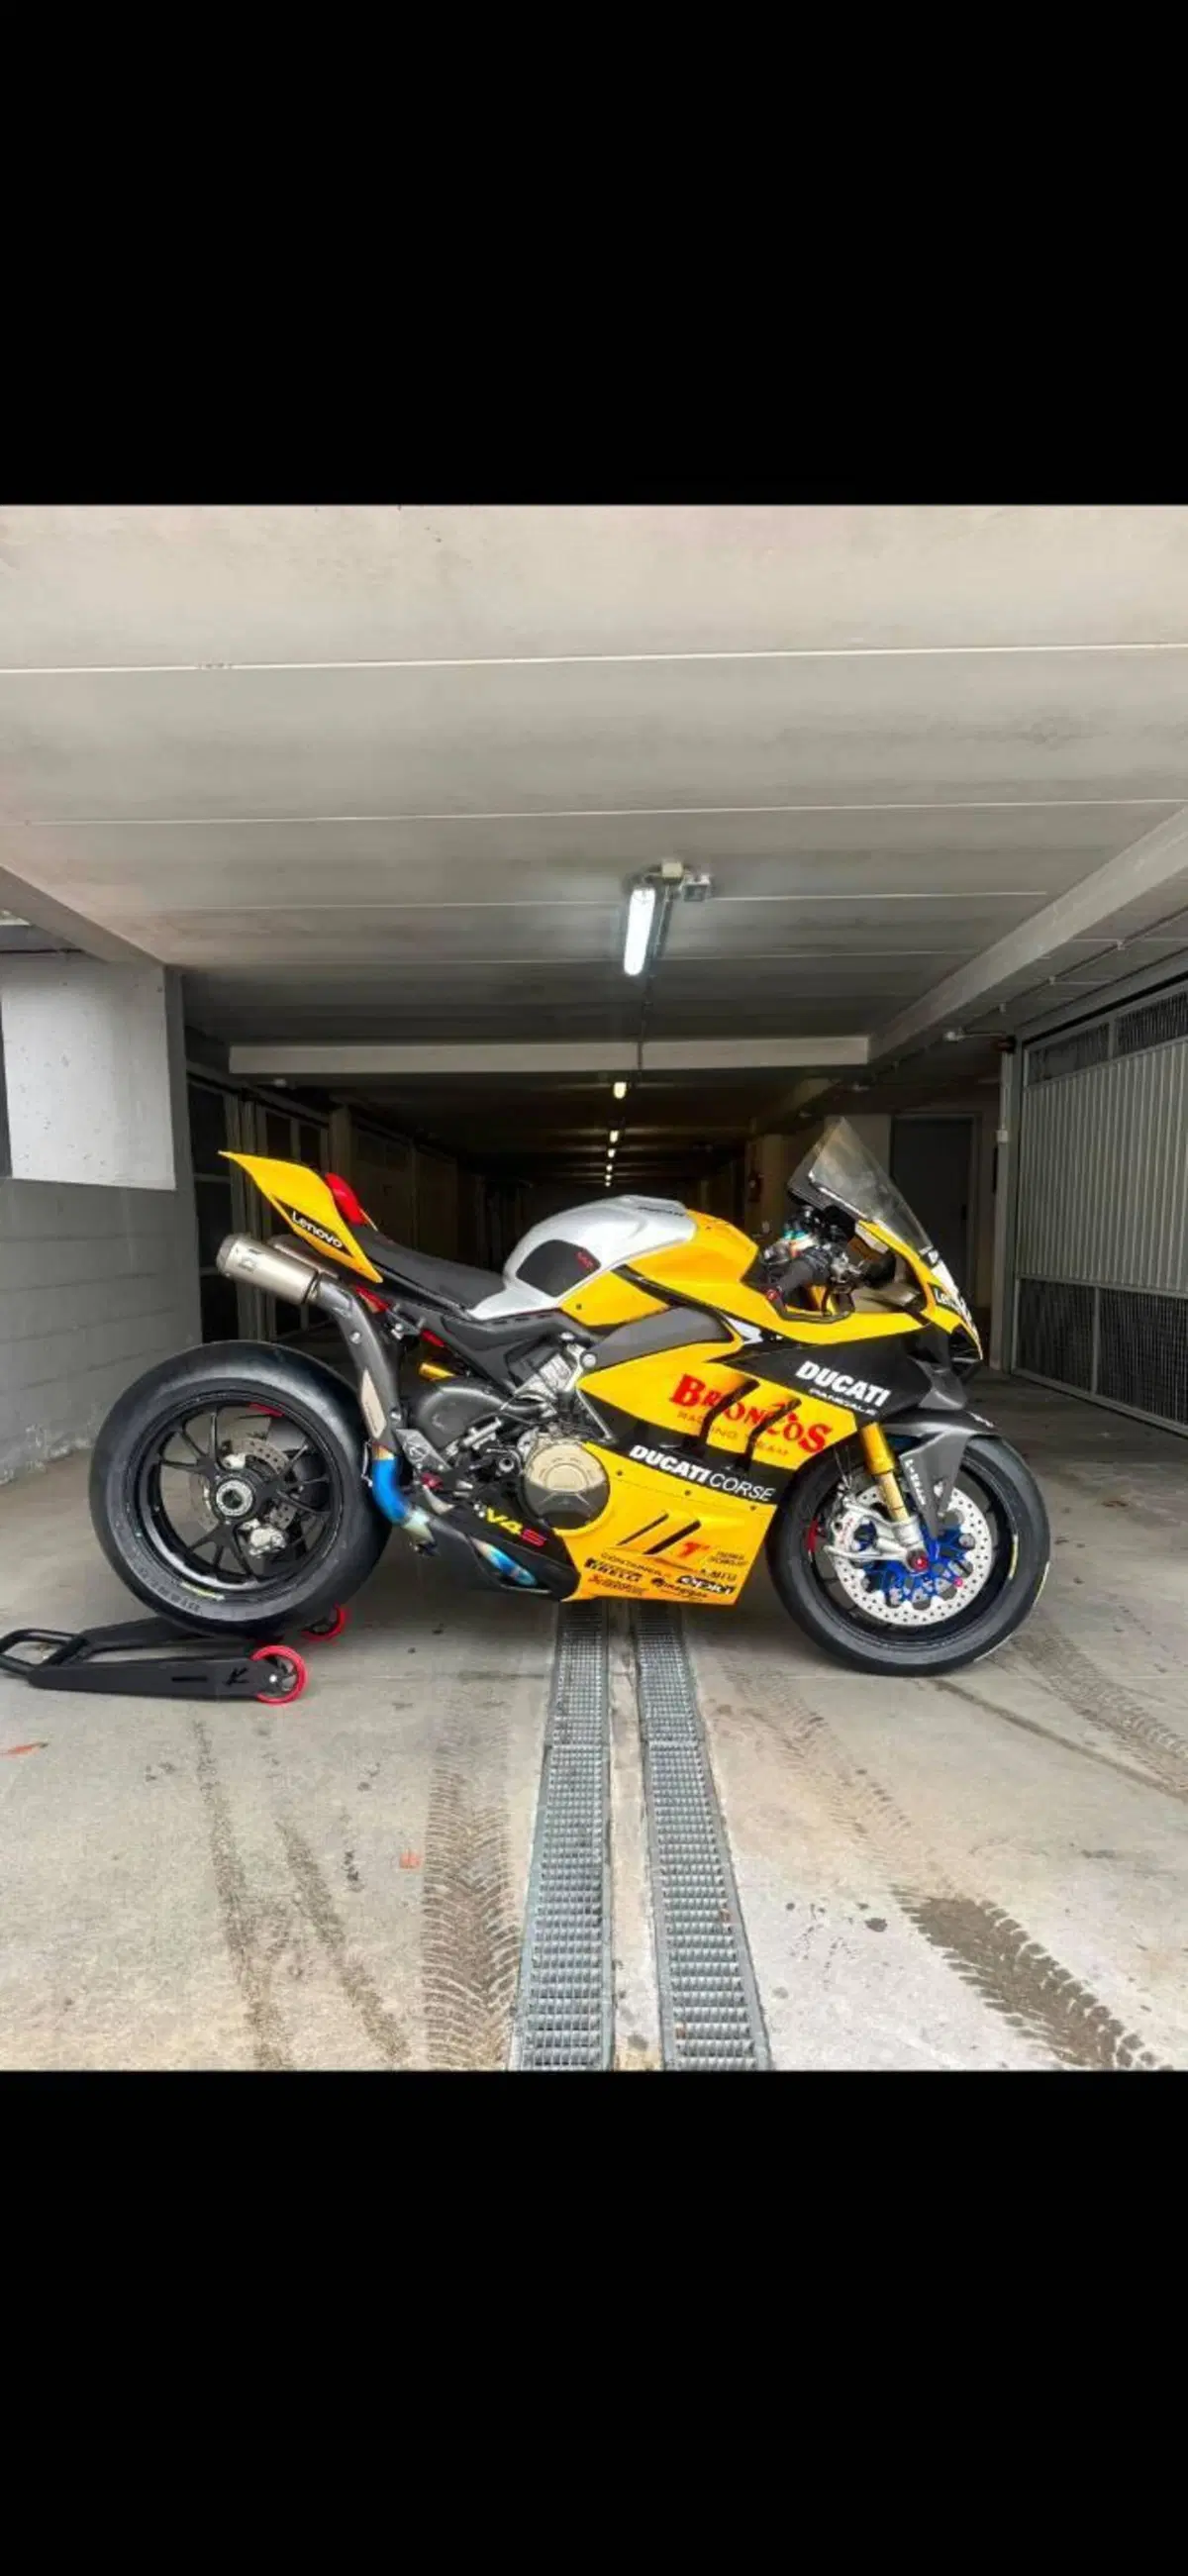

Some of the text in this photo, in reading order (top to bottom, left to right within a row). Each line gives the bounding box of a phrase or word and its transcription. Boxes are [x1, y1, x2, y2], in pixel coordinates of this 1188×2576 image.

[292, 1210, 343, 1247] Lenovo
[795, 1360, 891, 1407] DUCATI
[629, 1444, 776, 1502] DUCATI CORSE
